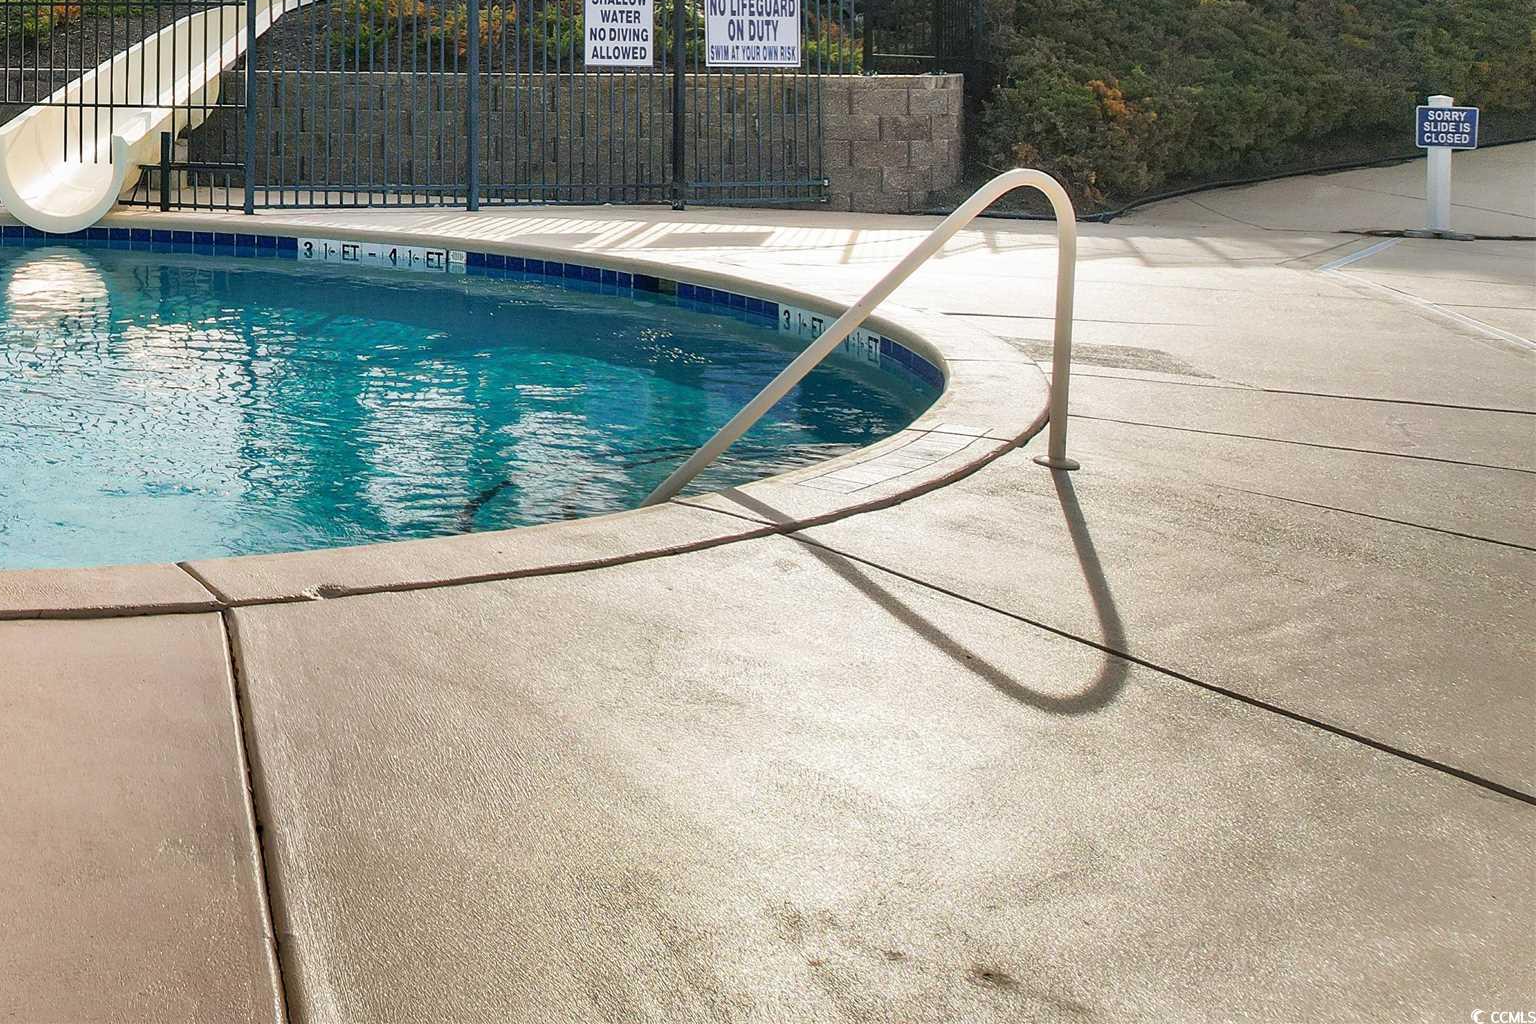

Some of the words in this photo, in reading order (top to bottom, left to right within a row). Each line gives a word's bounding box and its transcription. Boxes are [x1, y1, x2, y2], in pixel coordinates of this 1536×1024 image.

[600, 10, 641, 24] WATER
[590, 28, 606, 41] NO
[609, 28, 649, 42] DIVING
[728, 19, 744, 42] ON
[749, 19, 779, 42] DUTY
[592, 46, 647, 60] ALLOWED
[710, 45, 729, 61] SWIM
[731, 45, 740, 61] AT
[741, 45, 761, 61] YOUR
[763, 45, 779, 61] OWN
[780, 45, 797, 61] RISK
[1427, 110, 1467, 122] SORRY
[1423, 122, 1456, 132] SLIDE
[1459, 122, 1471, 133] IS
[1424, 133, 1470, 144] CLOSED
